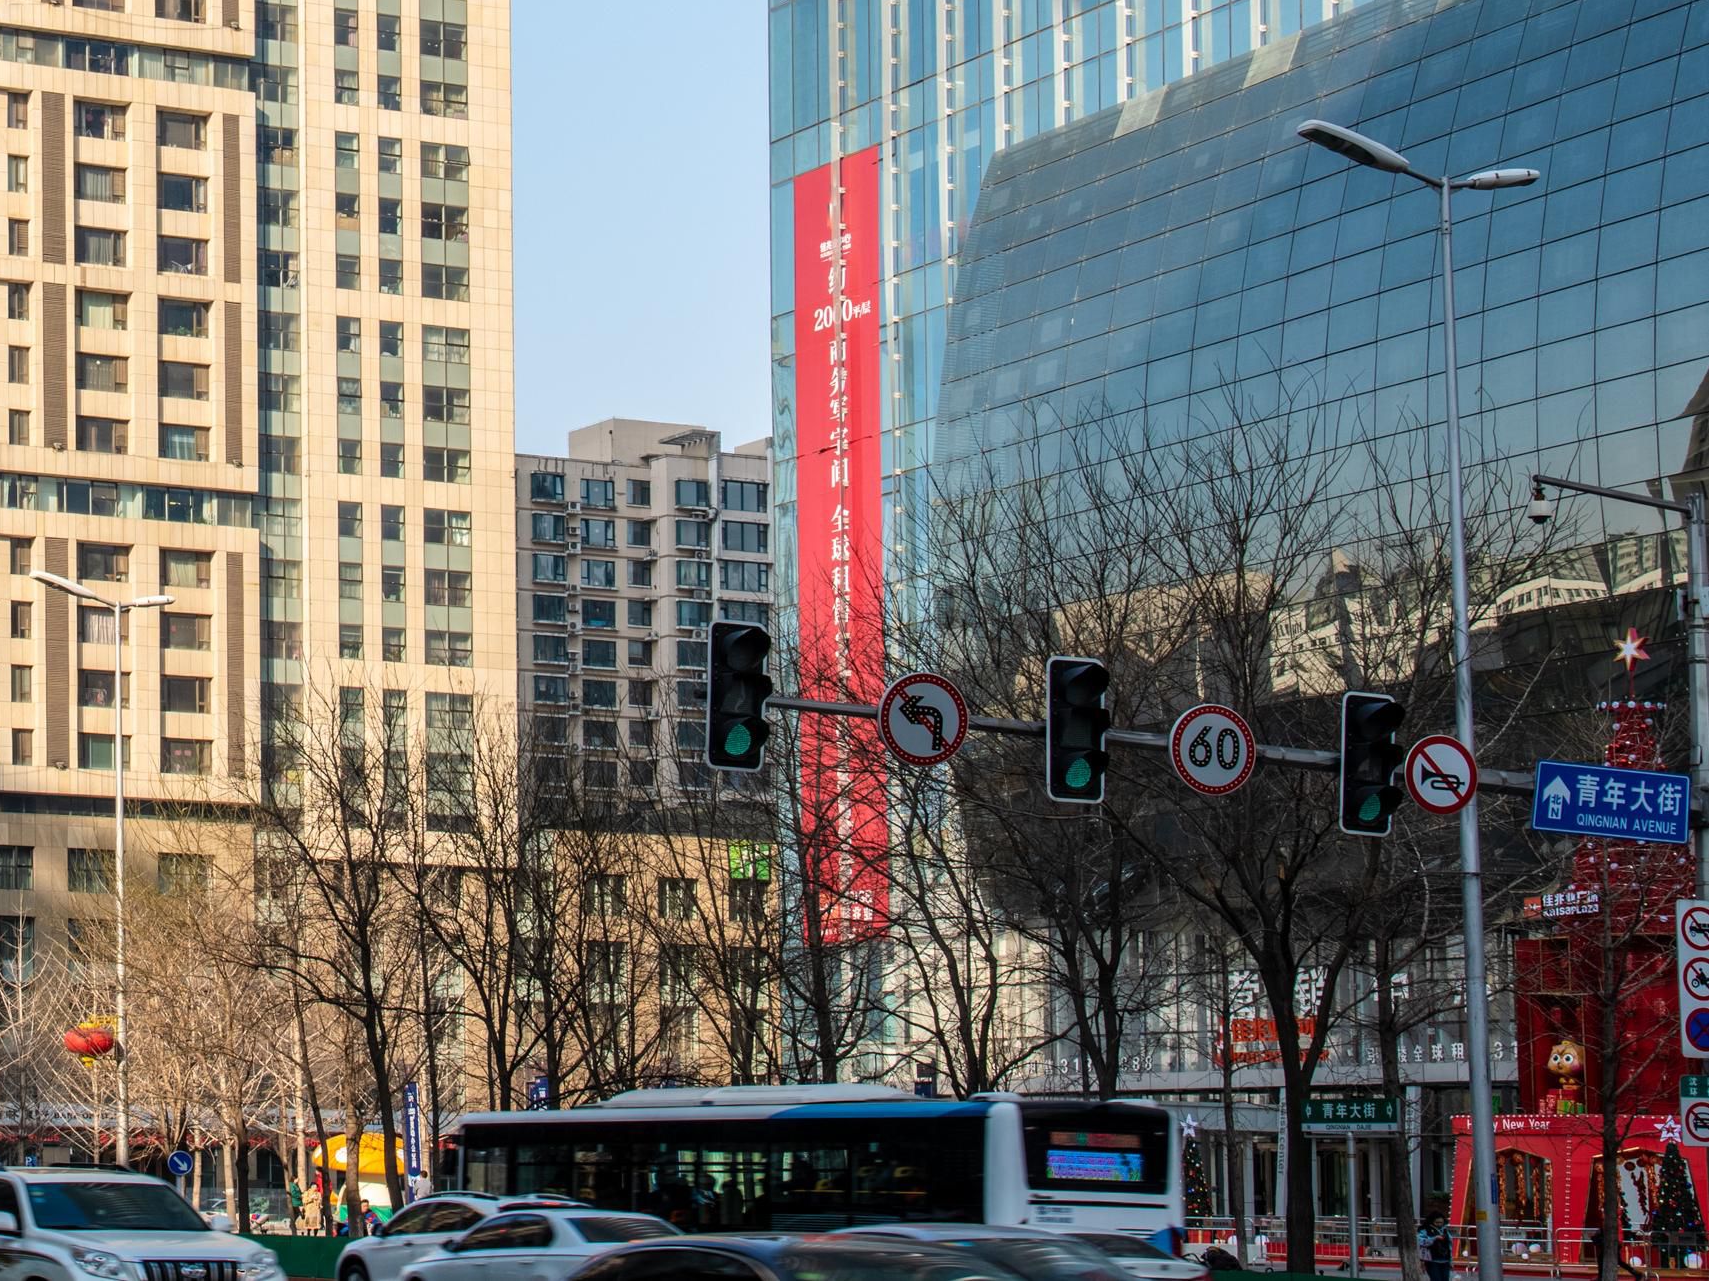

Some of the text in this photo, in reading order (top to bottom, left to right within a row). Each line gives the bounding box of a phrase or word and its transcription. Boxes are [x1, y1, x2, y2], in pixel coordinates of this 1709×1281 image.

[1188, 725, 1240, 771] 60
[1575, 774, 1683, 816] 青年大街
[1550, 807, 1560, 818] N
[1576, 813, 1677, 835] QINGNIAN AVENUE
[1322, 1102, 1376, 1119] 青年大街
[1502, 1119, 1524, 1130] New
[1528, 1118, 1551, 1130] Year
